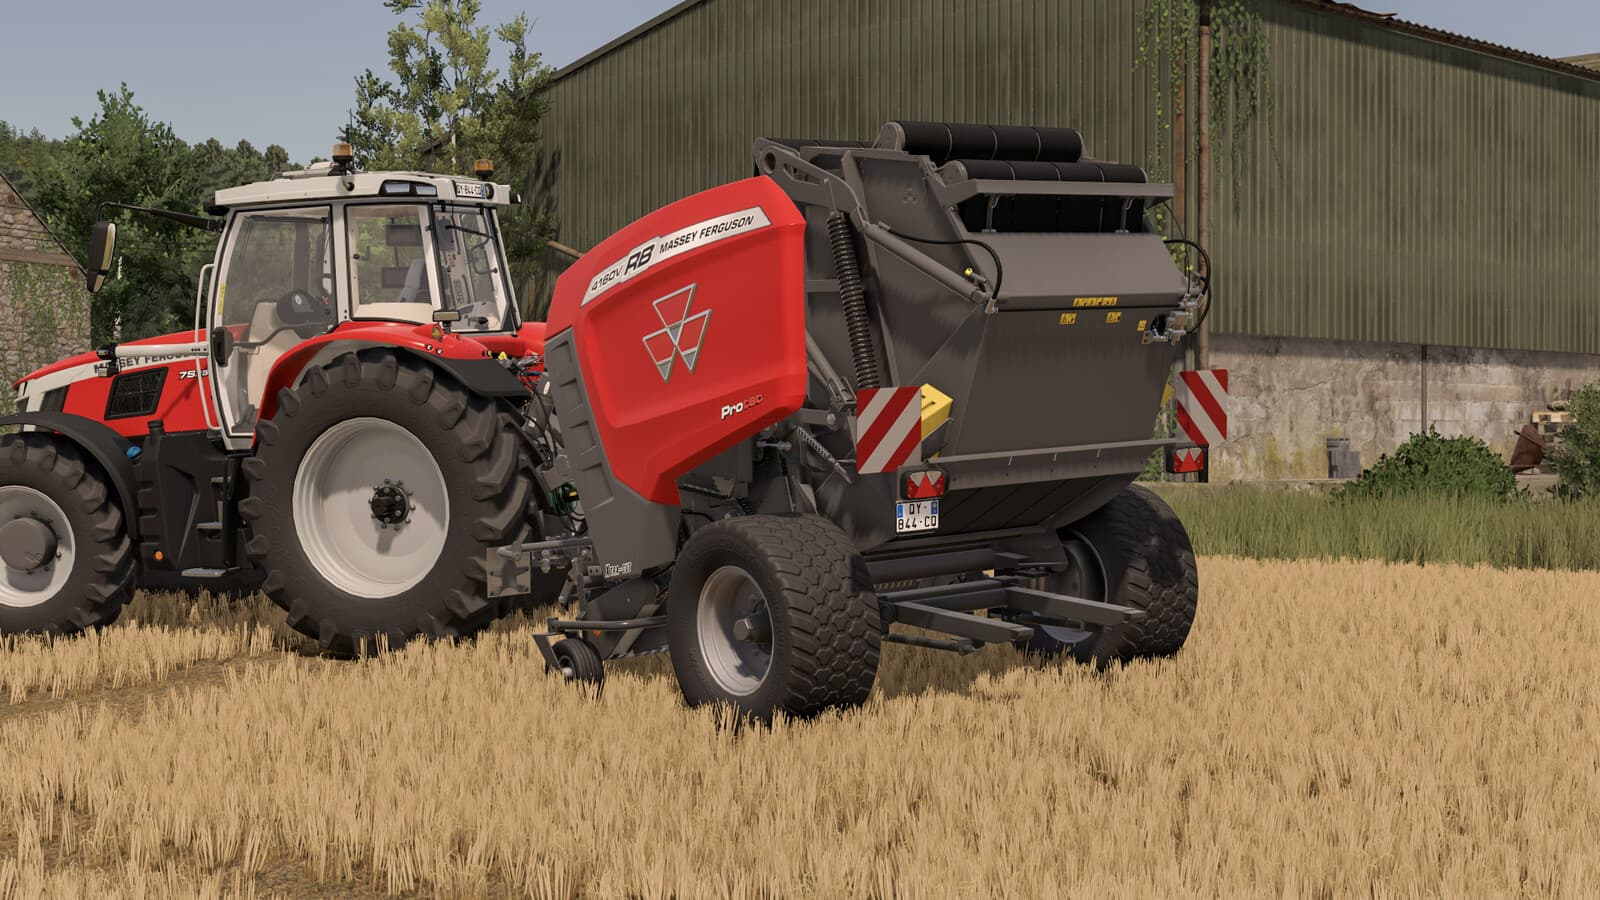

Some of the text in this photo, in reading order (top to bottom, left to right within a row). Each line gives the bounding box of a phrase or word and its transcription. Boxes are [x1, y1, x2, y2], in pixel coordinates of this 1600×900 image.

[624, 244, 655, 275] RB
[659, 231, 698, 254] MASSEY
[700, 215, 754, 238] FERGUSON
